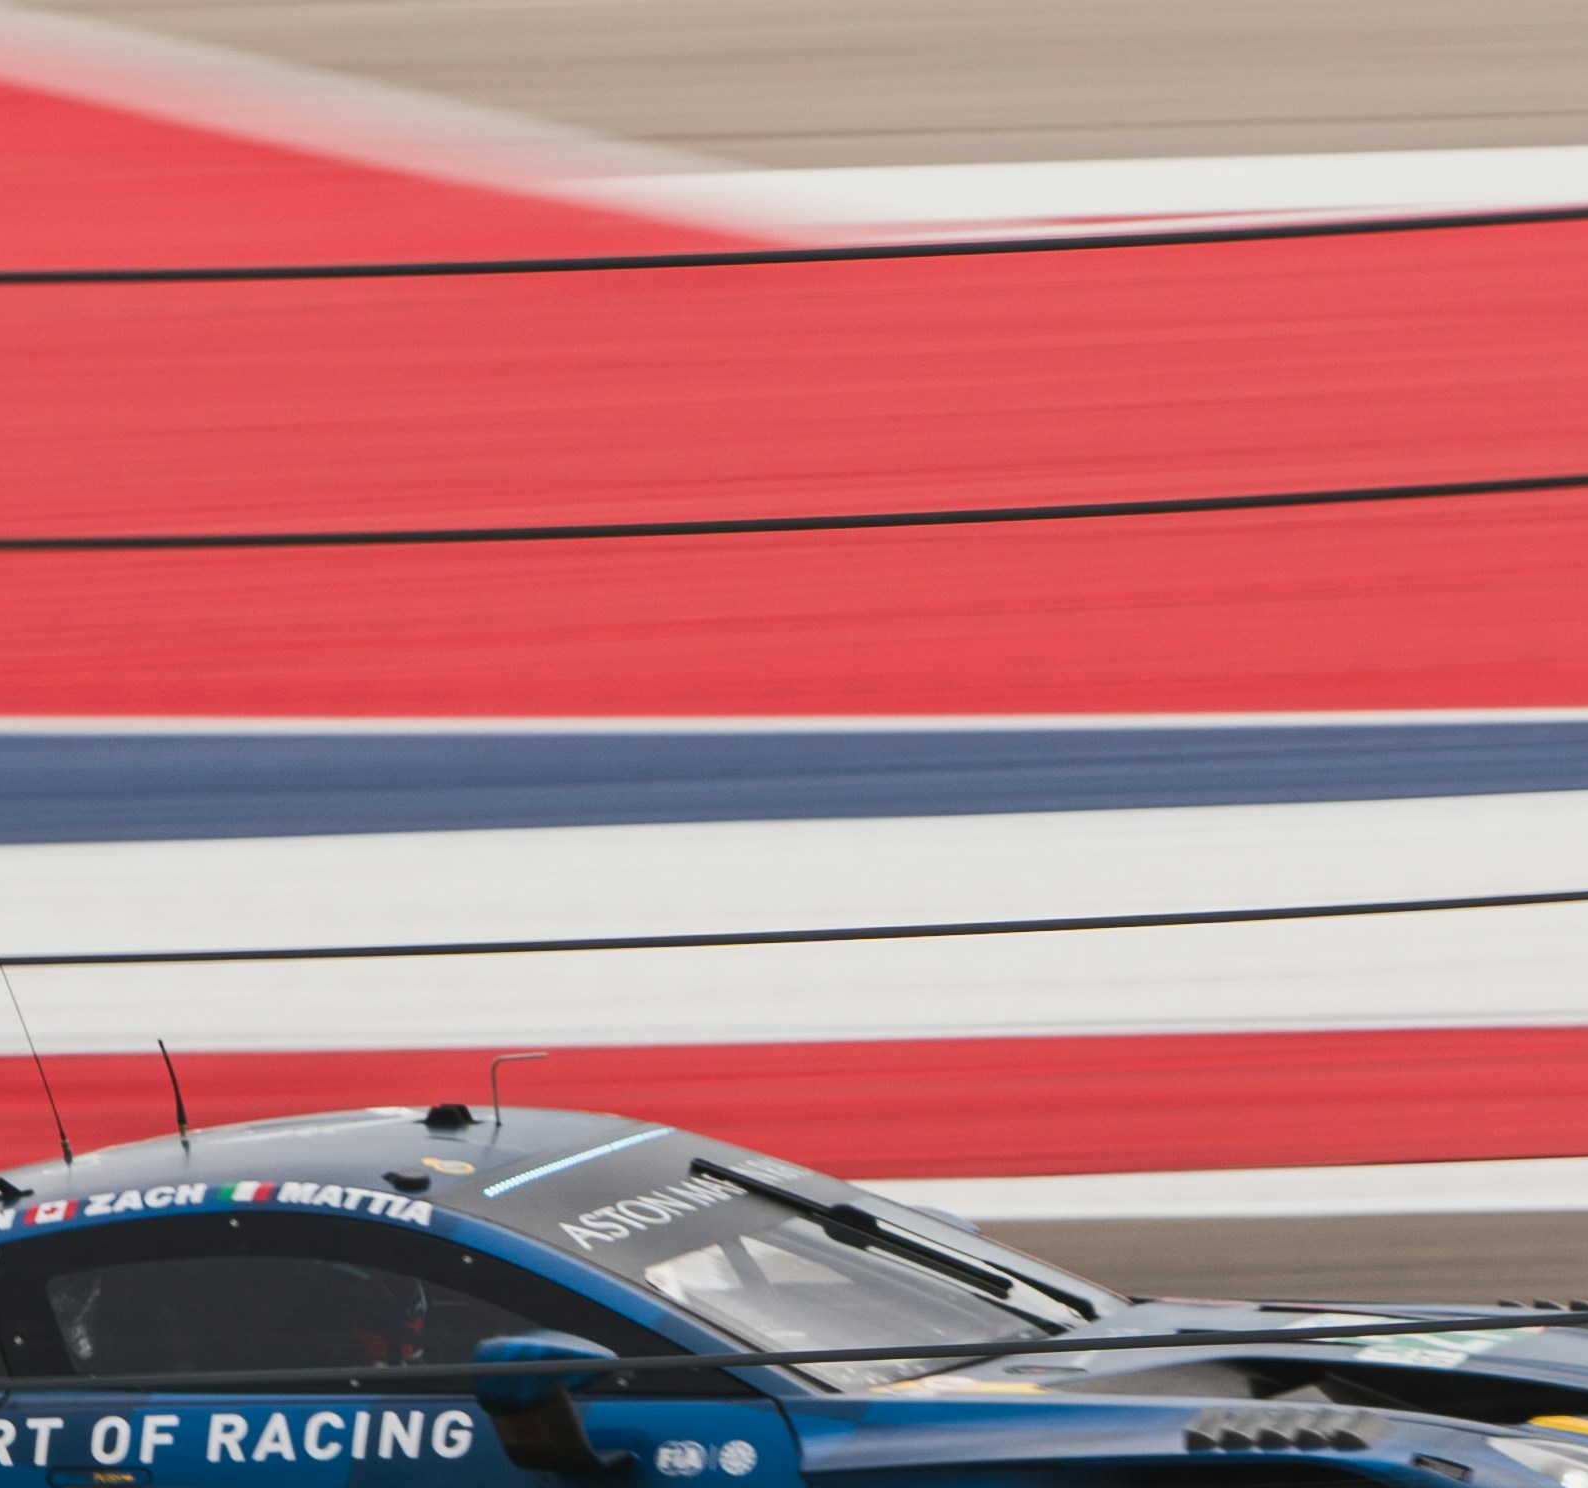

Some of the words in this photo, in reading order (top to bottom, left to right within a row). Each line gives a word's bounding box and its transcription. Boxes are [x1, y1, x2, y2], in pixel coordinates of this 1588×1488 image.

[84, 1184, 208, 1217] ZACH
[276, 1181, 433, 1227] MATTIA
[558, 1190, 699, 1250] ASTON
[90, 1414, 180, 1464] OF
[207, 1410, 475, 1463] RACING
